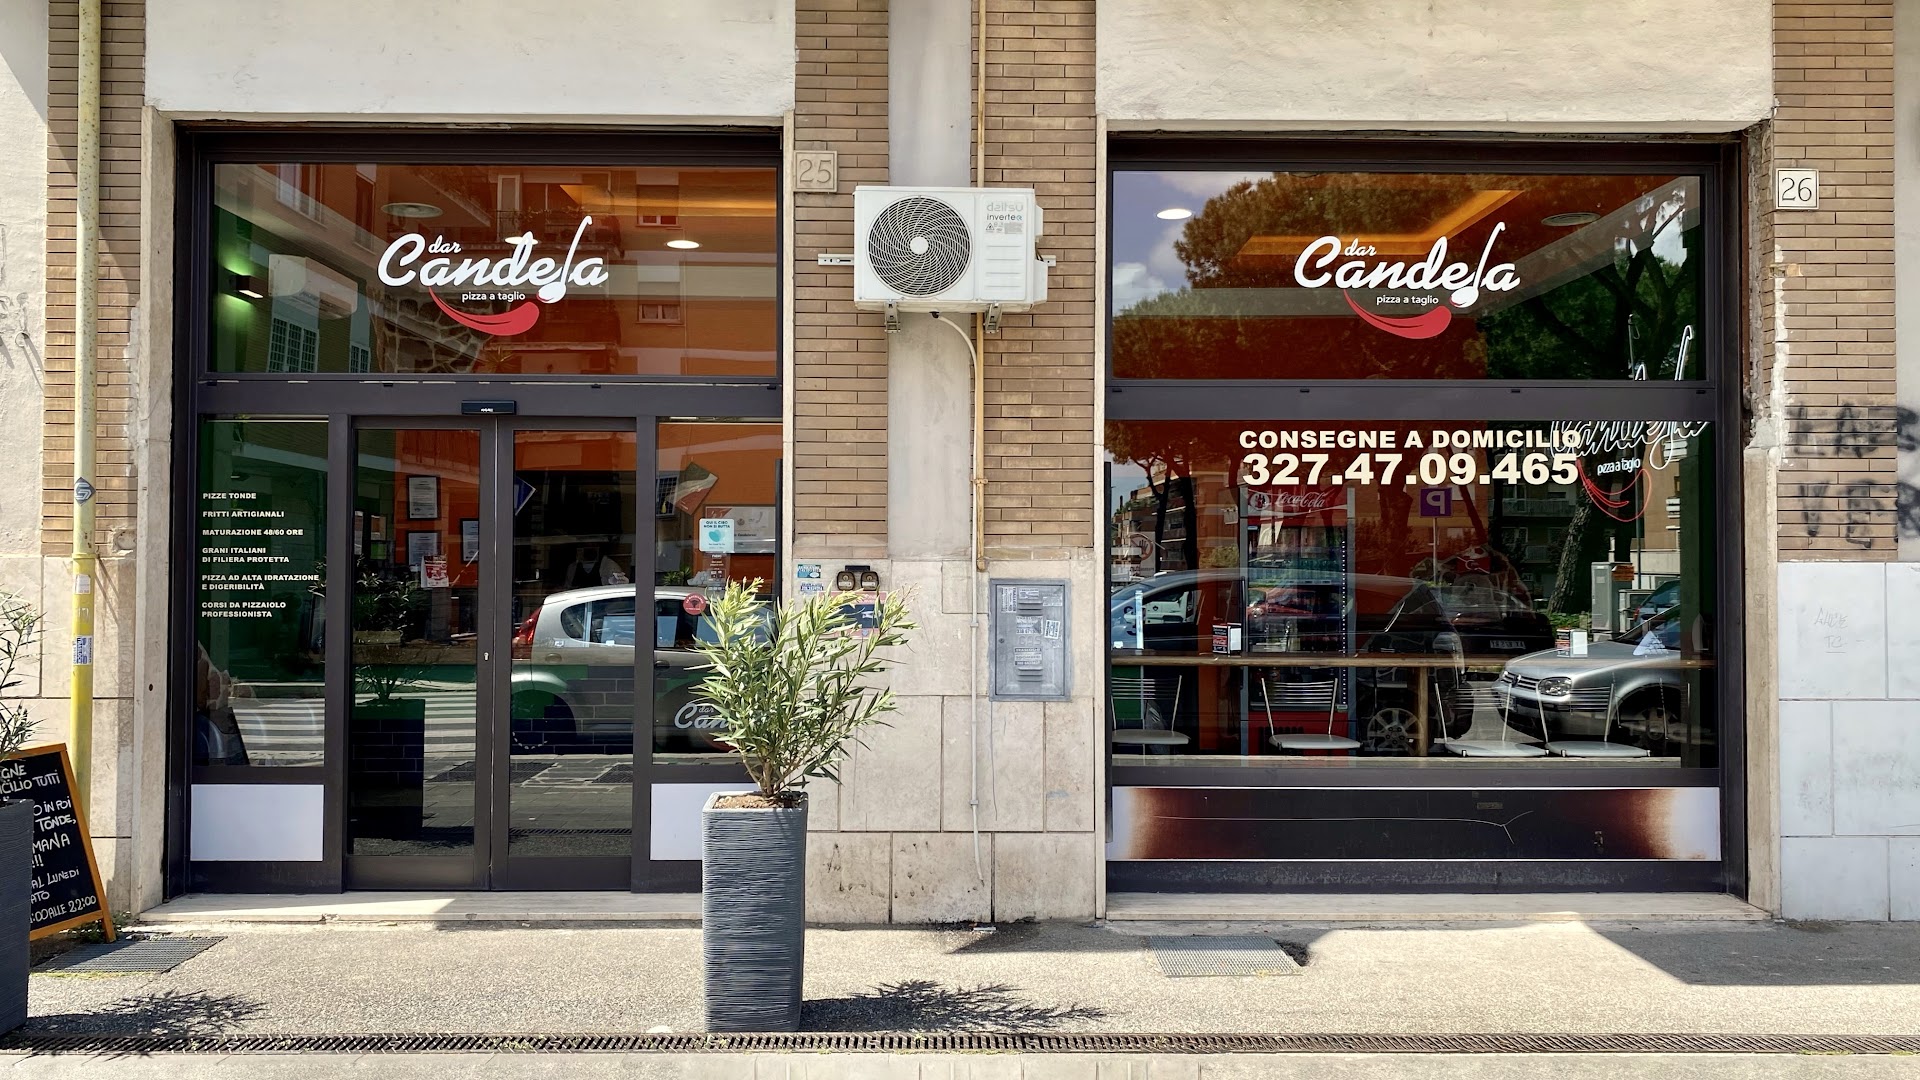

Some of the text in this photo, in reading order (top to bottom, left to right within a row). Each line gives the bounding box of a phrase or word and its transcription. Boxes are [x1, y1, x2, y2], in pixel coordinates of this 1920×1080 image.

[799, 158, 832, 183] 25
[1780, 177, 1813, 203] 26
[428, 235, 461, 255] dar
[1344, 238, 1377, 257] dar
[377, 215, 609, 304] Candela
[1294, 221, 1521, 308] Candela
[461, 290, 526, 304] pizza a taglio
[1376, 293, 1439, 306] pizza a taglio
[1239, 429, 1582, 449] CONSEGNE A DOMICILIO
[1241, 452, 1580, 486] 327.47.09.465
[208, 582, 265, 590] DIGERIBILITÀ
[1, 762, 27, 779] GNE
[33, 805, 43, 817] O
[32, 831, 71, 855] MANA
[31, 876, 45, 890] AL
[30, 890, 51, 905] ATO
[68, 895, 97, 914] 22:00
